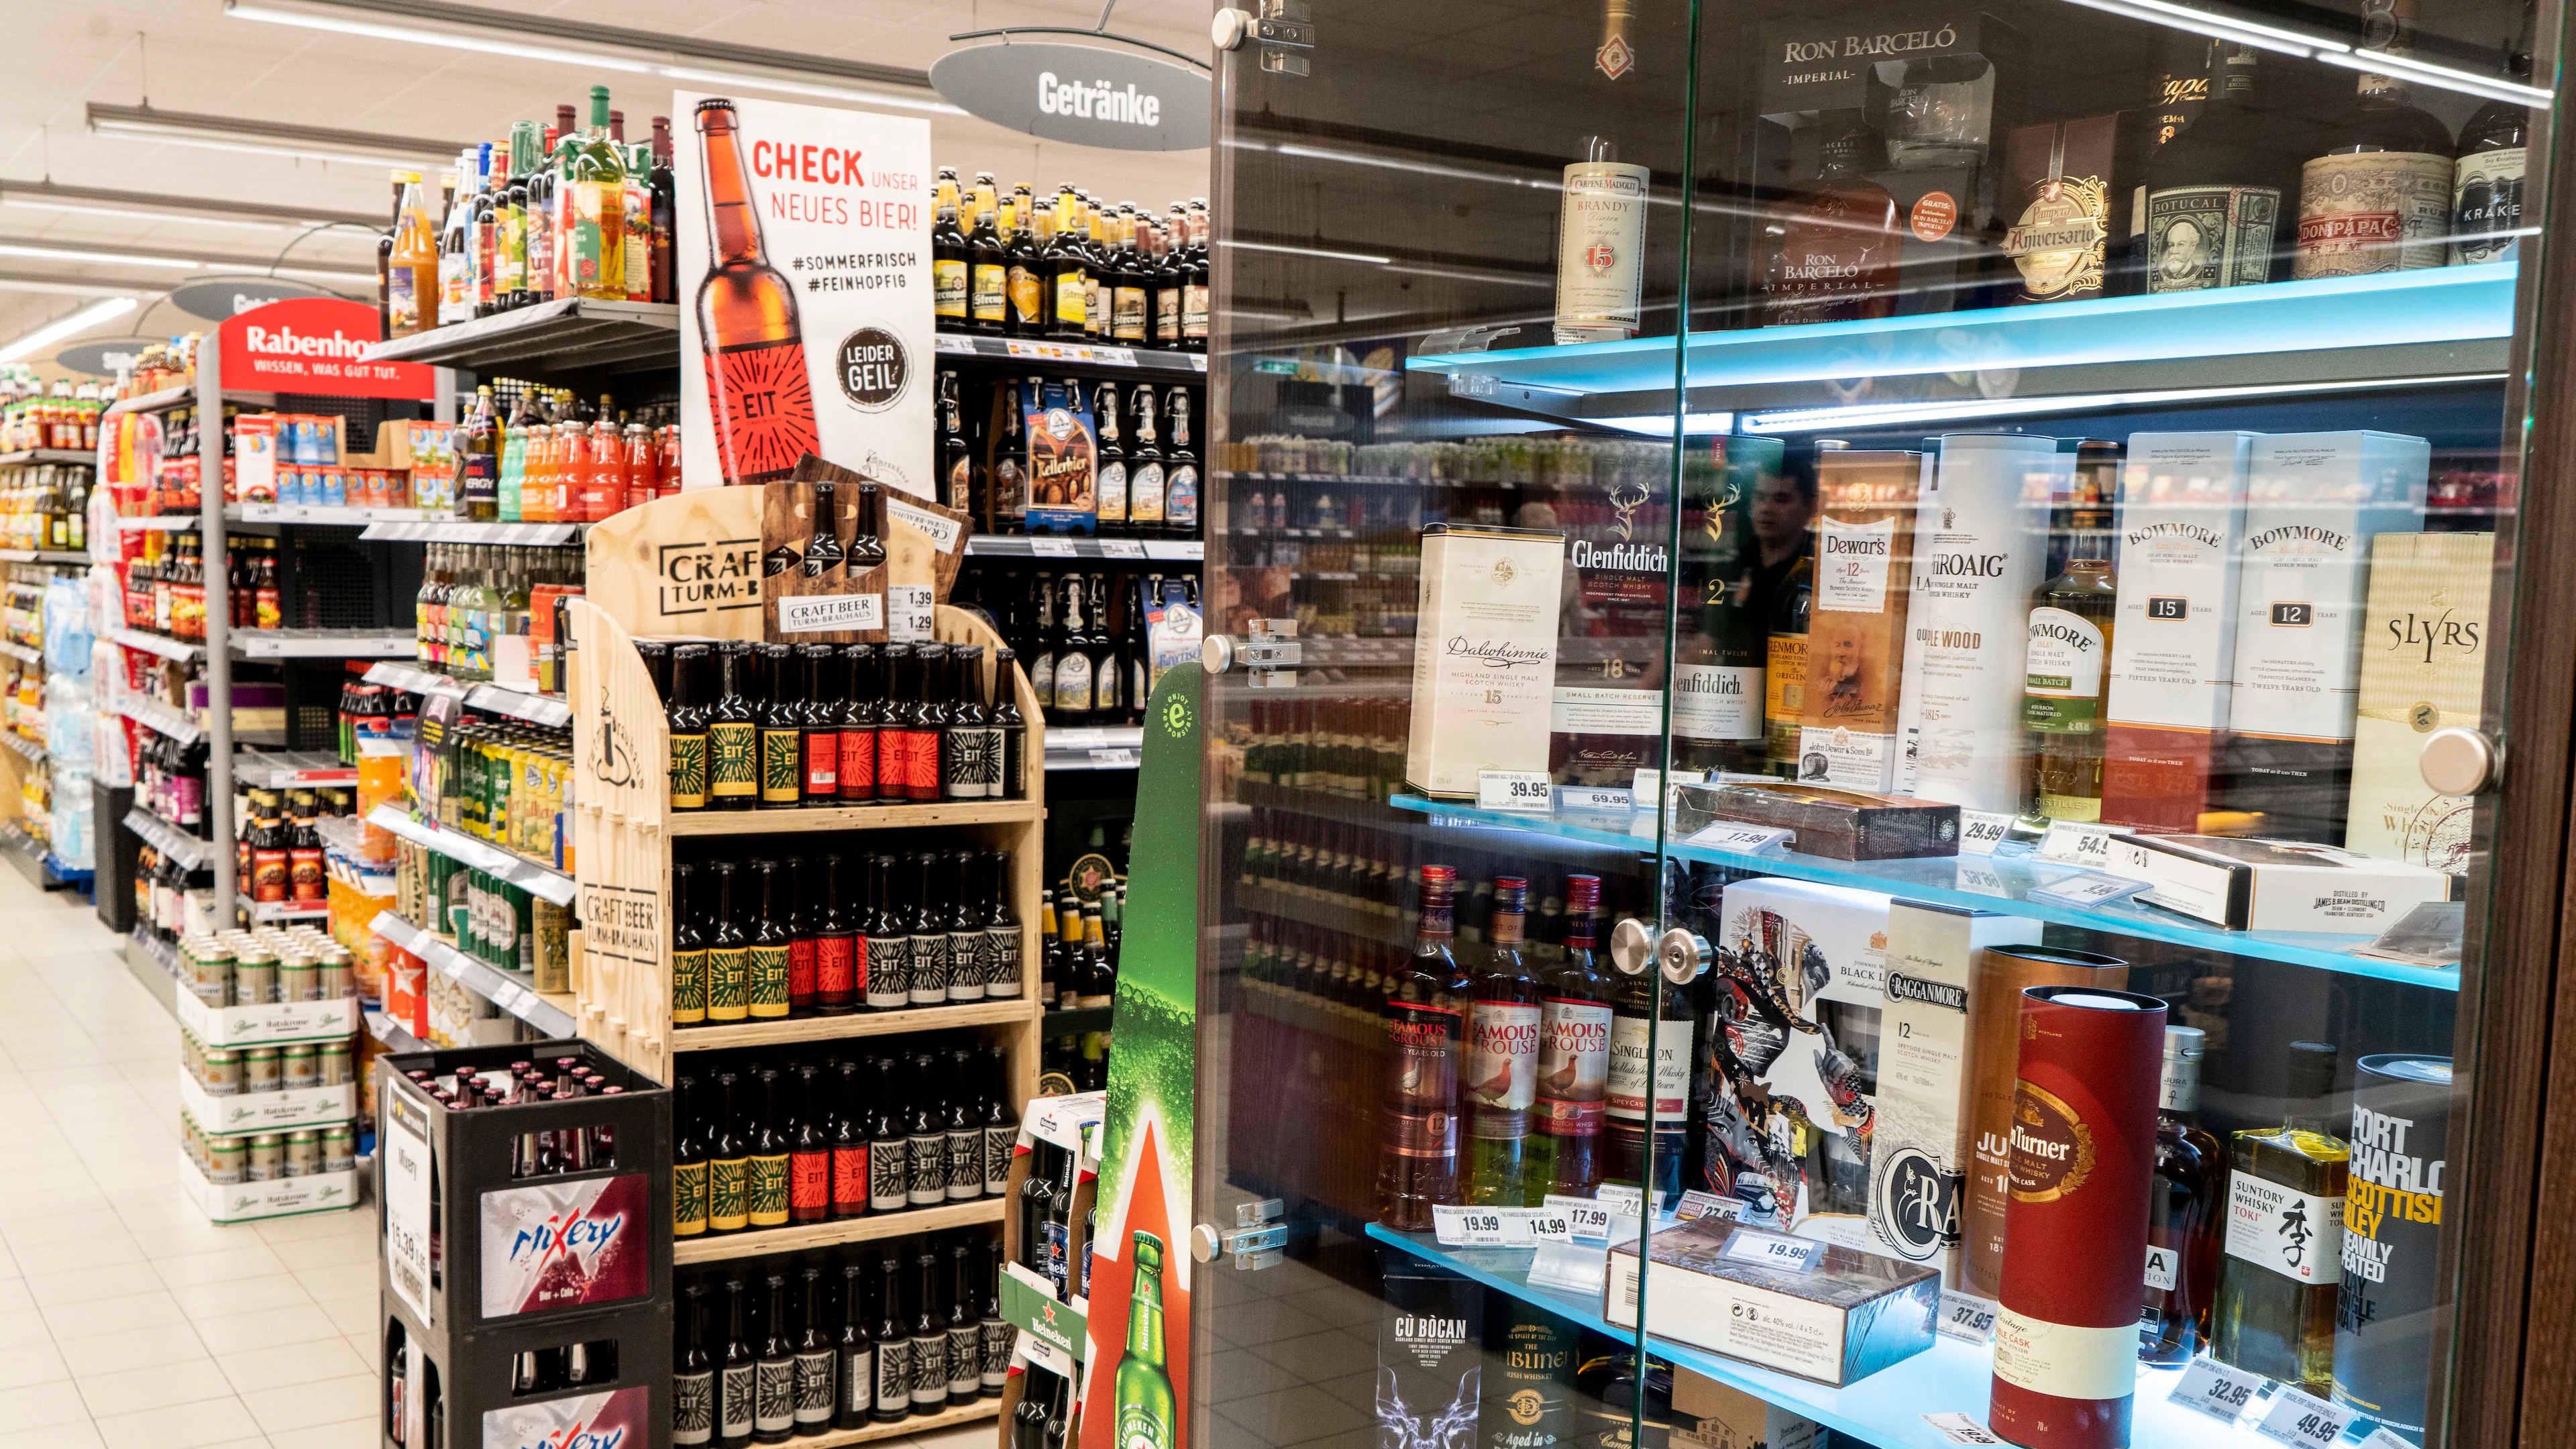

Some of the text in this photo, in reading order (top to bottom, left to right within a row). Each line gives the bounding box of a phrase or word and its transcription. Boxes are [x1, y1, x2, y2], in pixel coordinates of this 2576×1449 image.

[1784, 23, 1957, 63] RON BARCELÓ
[1038, 72, 1160, 126] Getränke
[1899, 88, 1917, 97] RON
[753, 140, 918, 191] CHECK UNSER
[771, 192, 918, 231] NEUES BIER!
[1577, 201, 1630, 212] BRANDY
[1923, 199, 1951, 209] GRATIS:
[2154, 198, 2220, 213] BOTUCAL
[2302, 219, 2380, 239] DON PAPA
[792, 252, 916, 271] #SOMMERFRISCH
[1585, 244, 1614, 269] 15
[1805, 254, 1837, 265] RON
[1784, 262, 1858, 279] BARCELÓ
[807, 274, 907, 292] #FEINHOPFIG
[247, 326, 380, 358] Rabenho
[847, 345, 895, 364] LEIDER
[254, 359, 400, 380] WISSEN, WAS GUT TUT.
[848, 364, 898, 392] GEIL
[743, 390, 777, 419] EIT
[886, 508, 950, 531] TURM-BRAUHAU
[2127, 522, 2224, 549] BOWMORE
[2250, 525, 2349, 552] BOWMORE
[1826, 535, 1886, 556] Dewar's
[1572, 539, 1668, 573] Glenfiddich
[1846, 562, 1860, 577] 12
[909, 592, 931, 605] 1.39
[791, 598, 869, 619] CRAFT BEER
[2127, 603, 2144, 611] AGED
[2158, 601, 2178, 616] 15
[2280, 606, 2302, 623] 12
[792, 609, 871, 627] TURM-BRAUHAUS
[909, 616, 931, 629] 1.29
[1942, 631, 1981, 650] WOOD
[2387, 608, 2479, 664] SLYRS
[1446, 634, 1550, 667] Dalwhinnie
[1451, 672, 1485, 680] HIGHLAND
[1487, 672, 1513, 681] SINGLE
[1602, 658, 1623, 678] 18
[1465, 679, 1494, 687] SCOTCH
[2043, 677, 2068, 686] BATCH
[2129, 674, 2196, 686] FIFTEEN YEARS OLD
[2251, 683, 2321, 693] TWELVE YEARS OLD
[1484, 690, 1503, 704] 15
[1566, 692, 1656, 701] SMALL BATCH RESERVE
[724, 745, 743, 759] EIT
[965, 749, 981, 761] EIT
[1825, 743, 1845, 753] Dewar
[1511, 781, 1548, 798] 39.95
[1592, 794, 1629, 804] 69.95
[1727, 831, 1768, 844] 17.99
[1965, 822, 2005, 841] 29.99
[586, 896, 654, 930] CRAFT BEER
[588, 925, 654, 953] TURM-BRAUHAUS
[881, 959, 899, 971] EIT
[1841, 967, 1876, 981] BLACK
[767, 968, 784, 981] EIT
[1886, 971, 1963, 1008] CRAGGANMORE
[1393, 1021, 1447, 1036] FAMOUS
[1475, 1024, 1537, 1040] AMOUS
[1898, 1021, 1911, 1039] 12
[1393, 1031, 1446, 1048] GROUSE
[2164, 1075, 2188, 1086] JURA
[1432, 1116, 1444, 1130] 12
[2353, 1104, 2414, 1155] PORT
[1976, 1130, 2012, 1157] JU
[398, 1146, 417, 1181] Mixery
[1063, 1154, 1072, 1187] Heineken
[765, 1177, 784, 1190] EIT
[2235, 1180, 2285, 1205] SUNTORY
[1681, 1201, 1704, 1212] UNSER
[2235, 1192, 2276, 1214] WHISKY
[1572, 1209, 1607, 1226] 17.99
[2234, 1205, 2259, 1222] TOKI
[1462, 1216, 1500, 1232] 19.99
[1529, 1219, 1566, 1235] 14.99
[391, 1220, 415, 1262] 15.39
[2342, 1230, 2394, 1265] HEAVILY
[1768, 1242, 1810, 1260] 19.99
[2340, 1249, 2385, 1285] PEATED
[539, 1287, 574, 1302] Bier Cola
[1951, 1307, 1994, 1330] 37.95
[1032, 1318, 1072, 1350] Heineken
[2208, 1378, 2253, 1406] 32.95
[1120, 1419, 1155, 1448] HEINEKEN
[2296, 1413, 2341, 1442] 49.95
[1505, 1432, 1532, 1448] Aged
